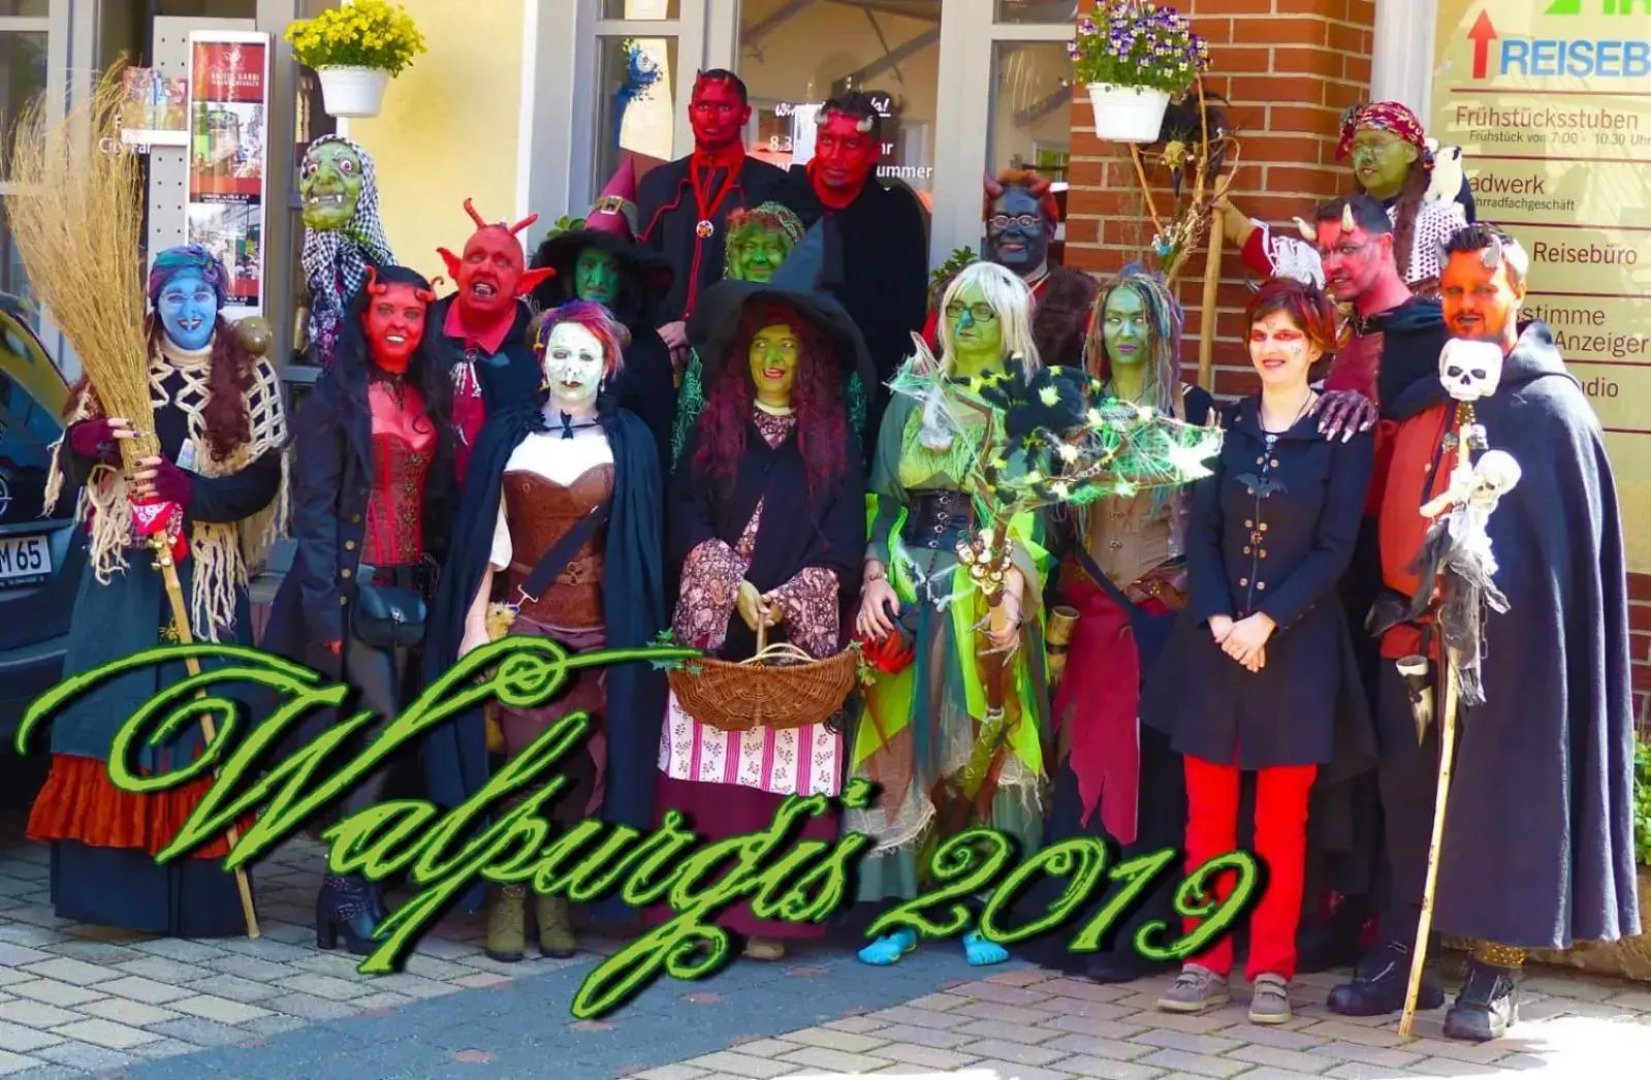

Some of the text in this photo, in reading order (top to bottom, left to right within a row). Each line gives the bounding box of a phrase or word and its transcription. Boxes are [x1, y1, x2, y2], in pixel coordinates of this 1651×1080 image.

[1456, 106, 1638, 130] Frühstücksstuben
[1469, 130, 1523, 143] Frühstück
[876, 165, 932, 179] ummer
[1470, 173, 1544, 194] adwerk
[1476, 196, 1575, 211] hrradfachgeschäft
[1533, 242, 1637, 265] Reisebüro
[1516, 304, 1605, 325] stimme
[1555, 331, 1649, 357] Anzeiger
[16, 540, 41, 571] 65
